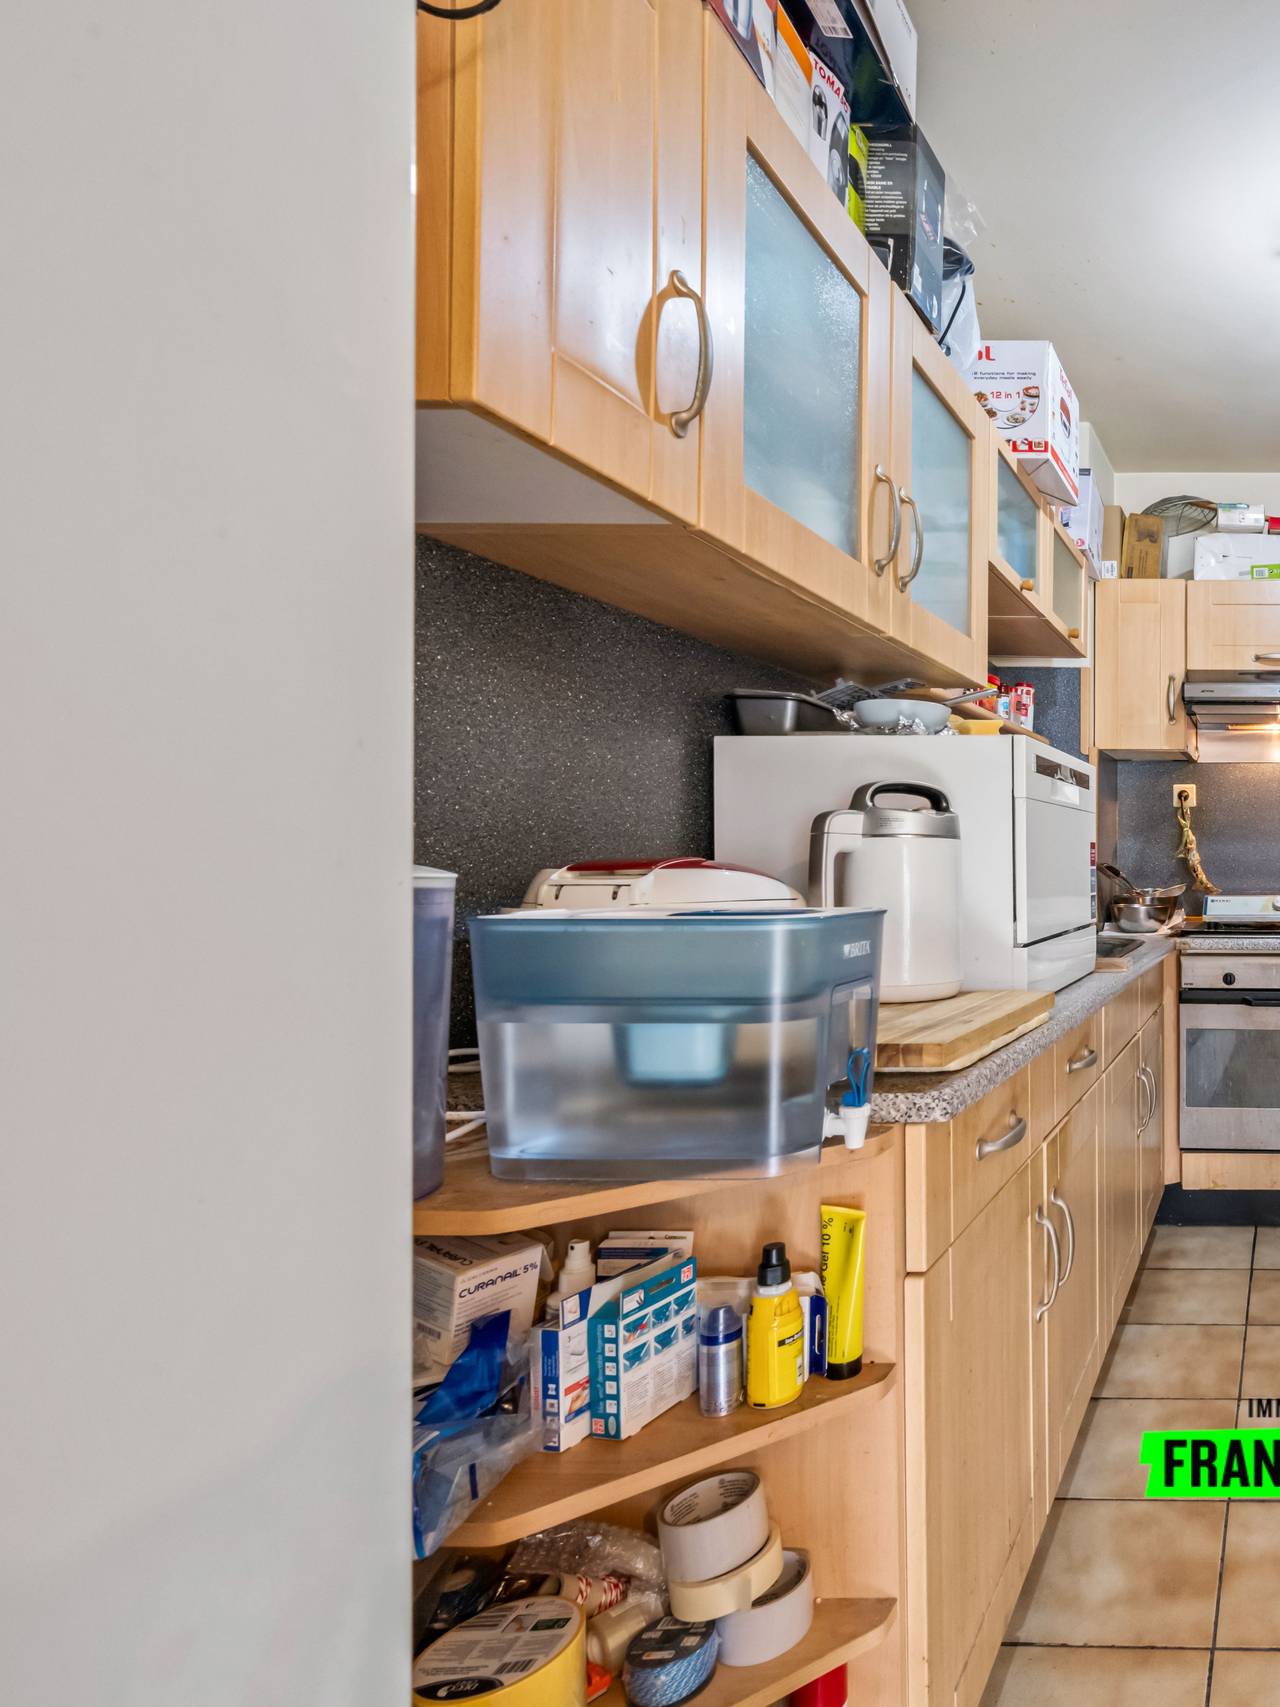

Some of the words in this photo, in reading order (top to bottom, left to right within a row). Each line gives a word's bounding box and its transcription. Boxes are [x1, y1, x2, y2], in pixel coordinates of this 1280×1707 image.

[990, 391, 1002, 399] 12
[1004, 391, 1013, 399] in
[822, 1217, 834, 1230] %
[821, 1233, 832, 1248] 10
[458, 1269, 521, 1299] CURANAIL
[523, 1262, 539, 1275] 5%
